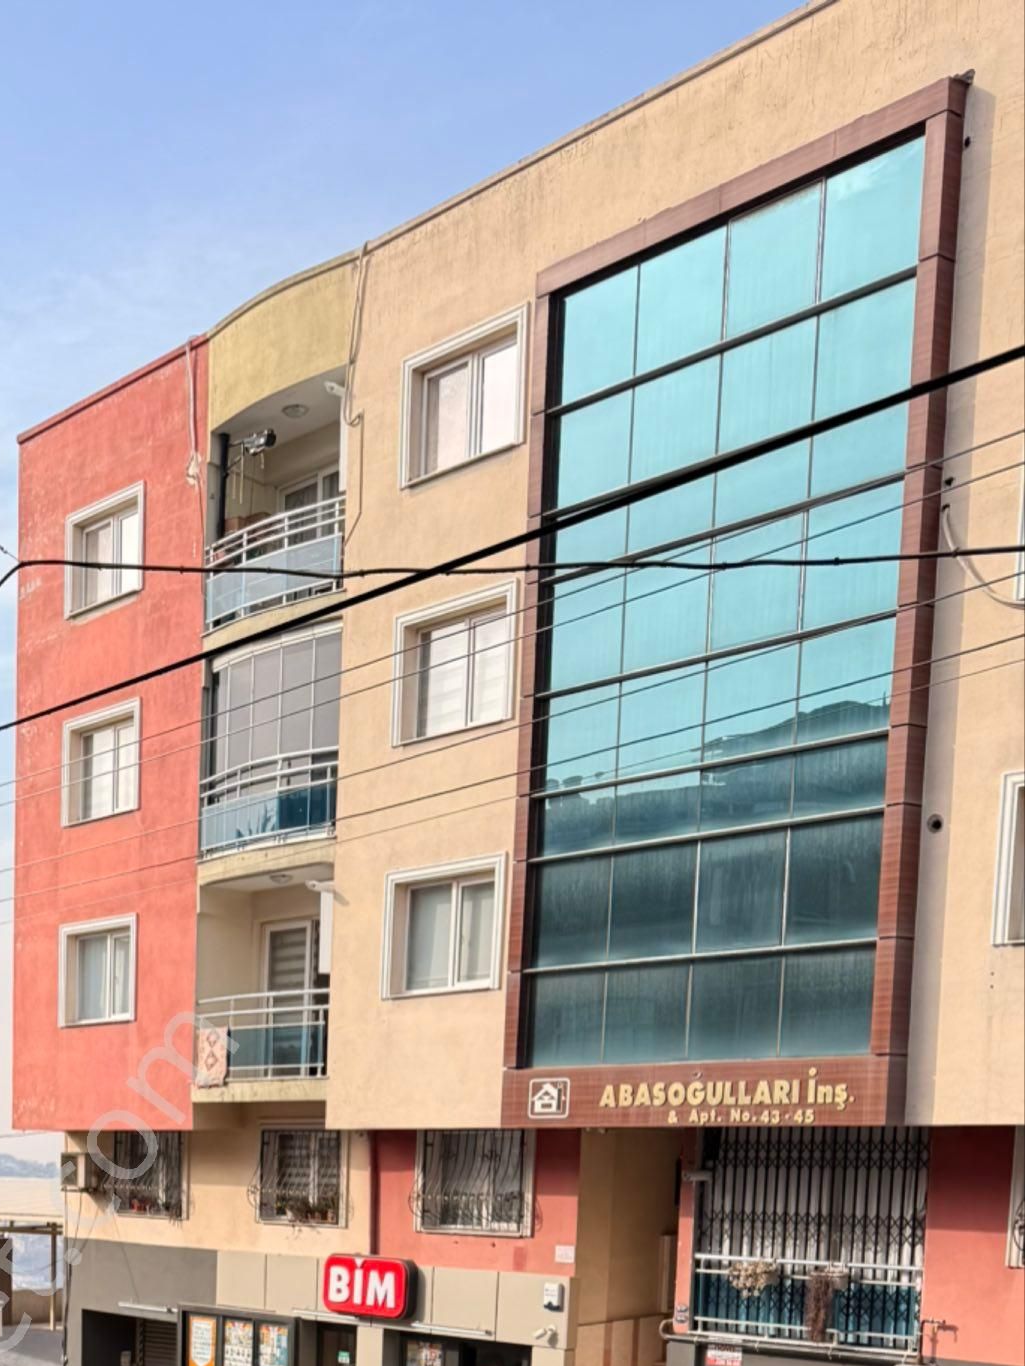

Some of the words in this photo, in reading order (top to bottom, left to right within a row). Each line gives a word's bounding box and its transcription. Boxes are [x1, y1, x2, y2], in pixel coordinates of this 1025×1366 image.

[599, 1071, 801, 1108] ABASOĞULLARI
[667, 1110, 678, 1124] &
[688, 1109, 722, 1126] Apt.
[327, 1257, 395, 1309] BİM
